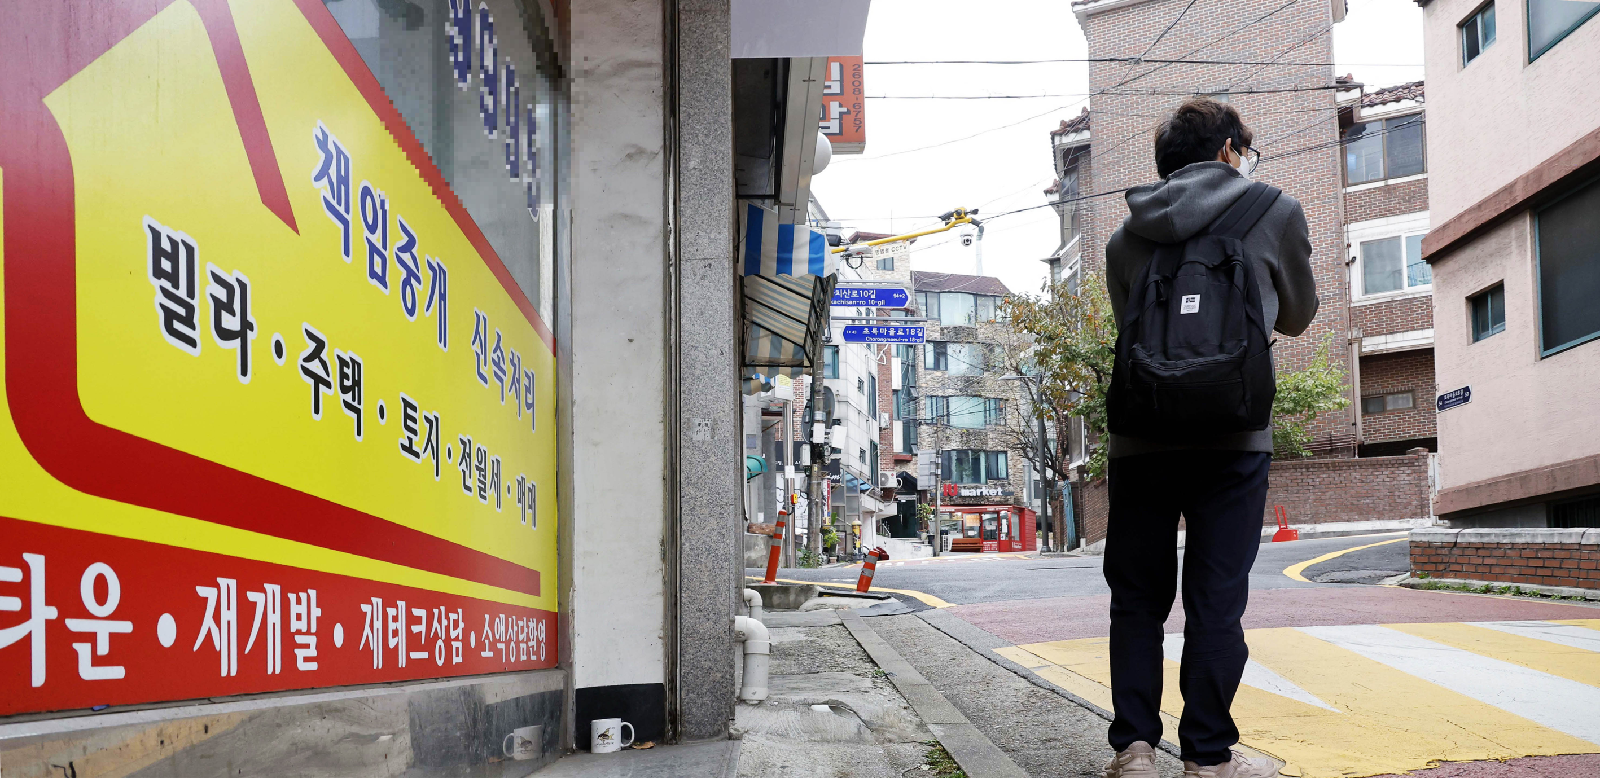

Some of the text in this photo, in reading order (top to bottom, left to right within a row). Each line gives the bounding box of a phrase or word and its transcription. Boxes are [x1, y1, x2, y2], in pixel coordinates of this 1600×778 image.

[852, 63, 863, 134] 2608-6757
[313, 124, 448, 350] 책임중개
[471, 309, 536, 431] 신속처리
[833, 288, 877, 299] 치산로10길
[862, 327, 924, 337] 초록마을로18길
[146, 222, 537, 528] 빌라 주택 토지 전월세 매매
[961, 486, 1003, 496] market
[0, 552, 546, 688] 타운 재개발 재테크상담 소액상담환영
